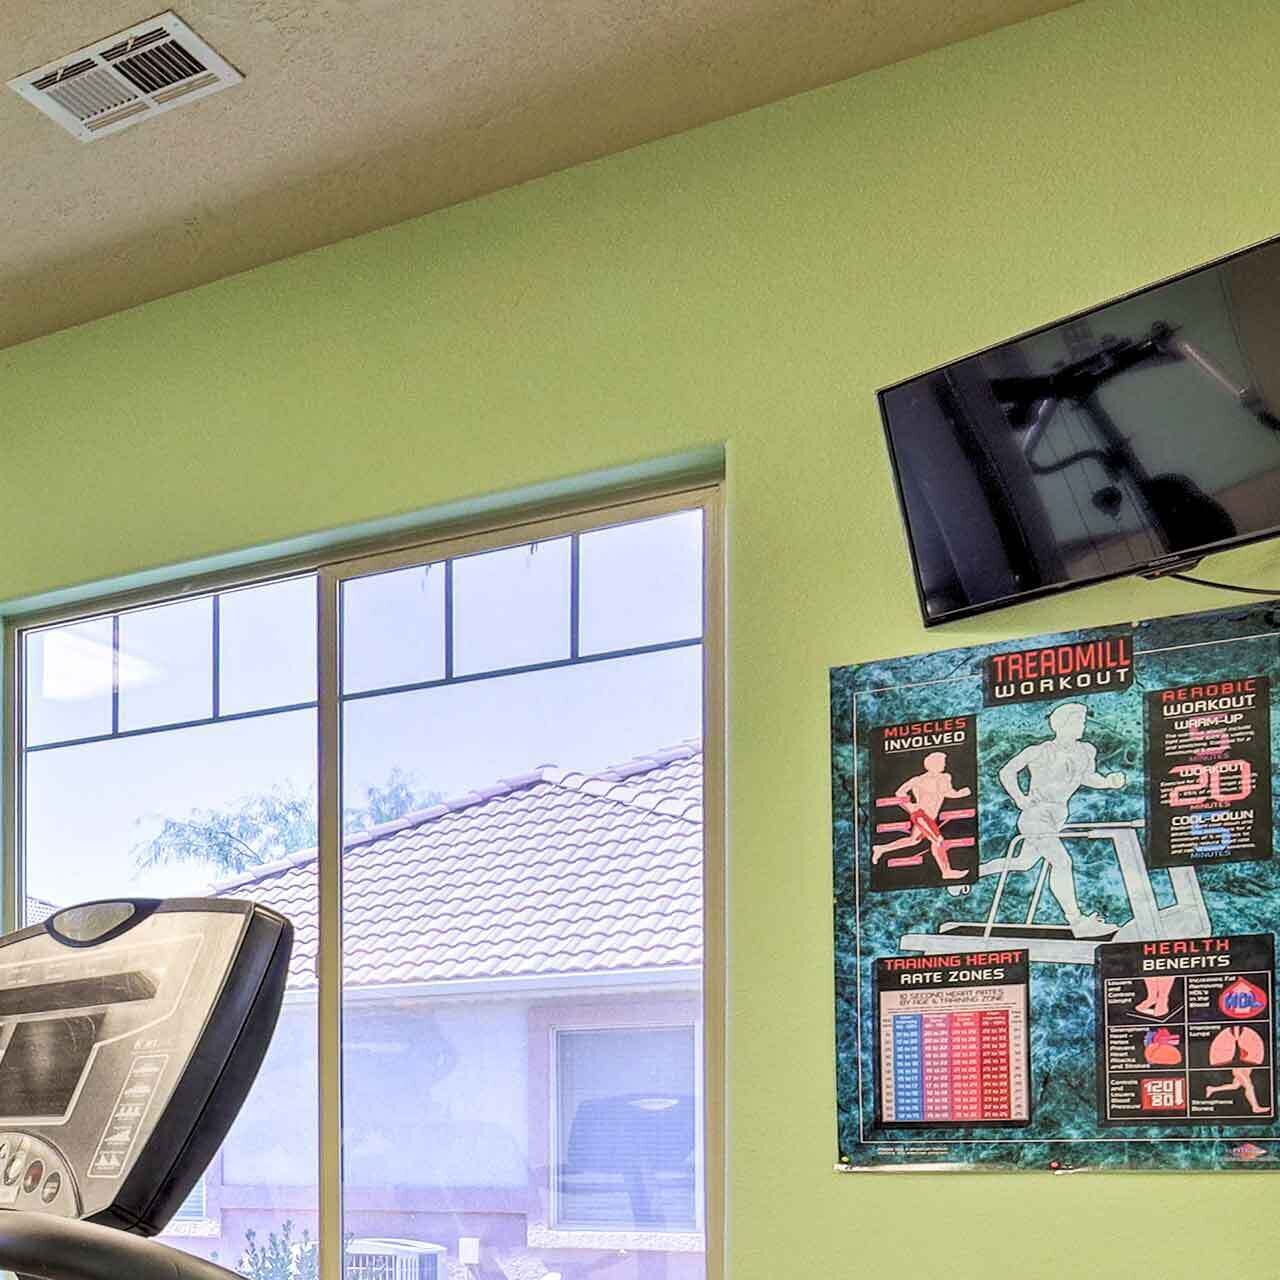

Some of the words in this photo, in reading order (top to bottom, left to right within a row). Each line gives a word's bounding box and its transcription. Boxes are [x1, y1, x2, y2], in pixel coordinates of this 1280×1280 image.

[992, 639, 1131, 682] TREADMILL
[994, 668, 1130, 698] WORKOUT
[1161, 680, 1257, 702] AEROBIC
[1163, 694, 1257, 716] WORKOUT
[883, 717, 967, 738] MUSCLES
[1174, 713, 1244, 730] WARM-UP
[884, 731, 966, 751] INVOLVED
[1179, 762, 1245, 778] WORKOUT
[1168, 760, 1252, 808] 20
[1189, 801, 1232, 811] MINUTES
[1171, 809, 1255, 827] COOL-DOWN
[1190, 850, 1232, 859] MINUTES
[1143, 939, 1230, 955] HEALTH
[884, 956, 961, 971] TRAINING
[966, 951, 1023, 966] HEART
[1143, 955, 1231, 971] BENEFITS
[900, 972, 943, 985] RATE
[949, 968, 1005, 982] ZONES
[910, 991, 945, 999] SECOND
[1143, 1080, 1174, 1093] 120
[1151, 1094, 1174, 1107] 80
